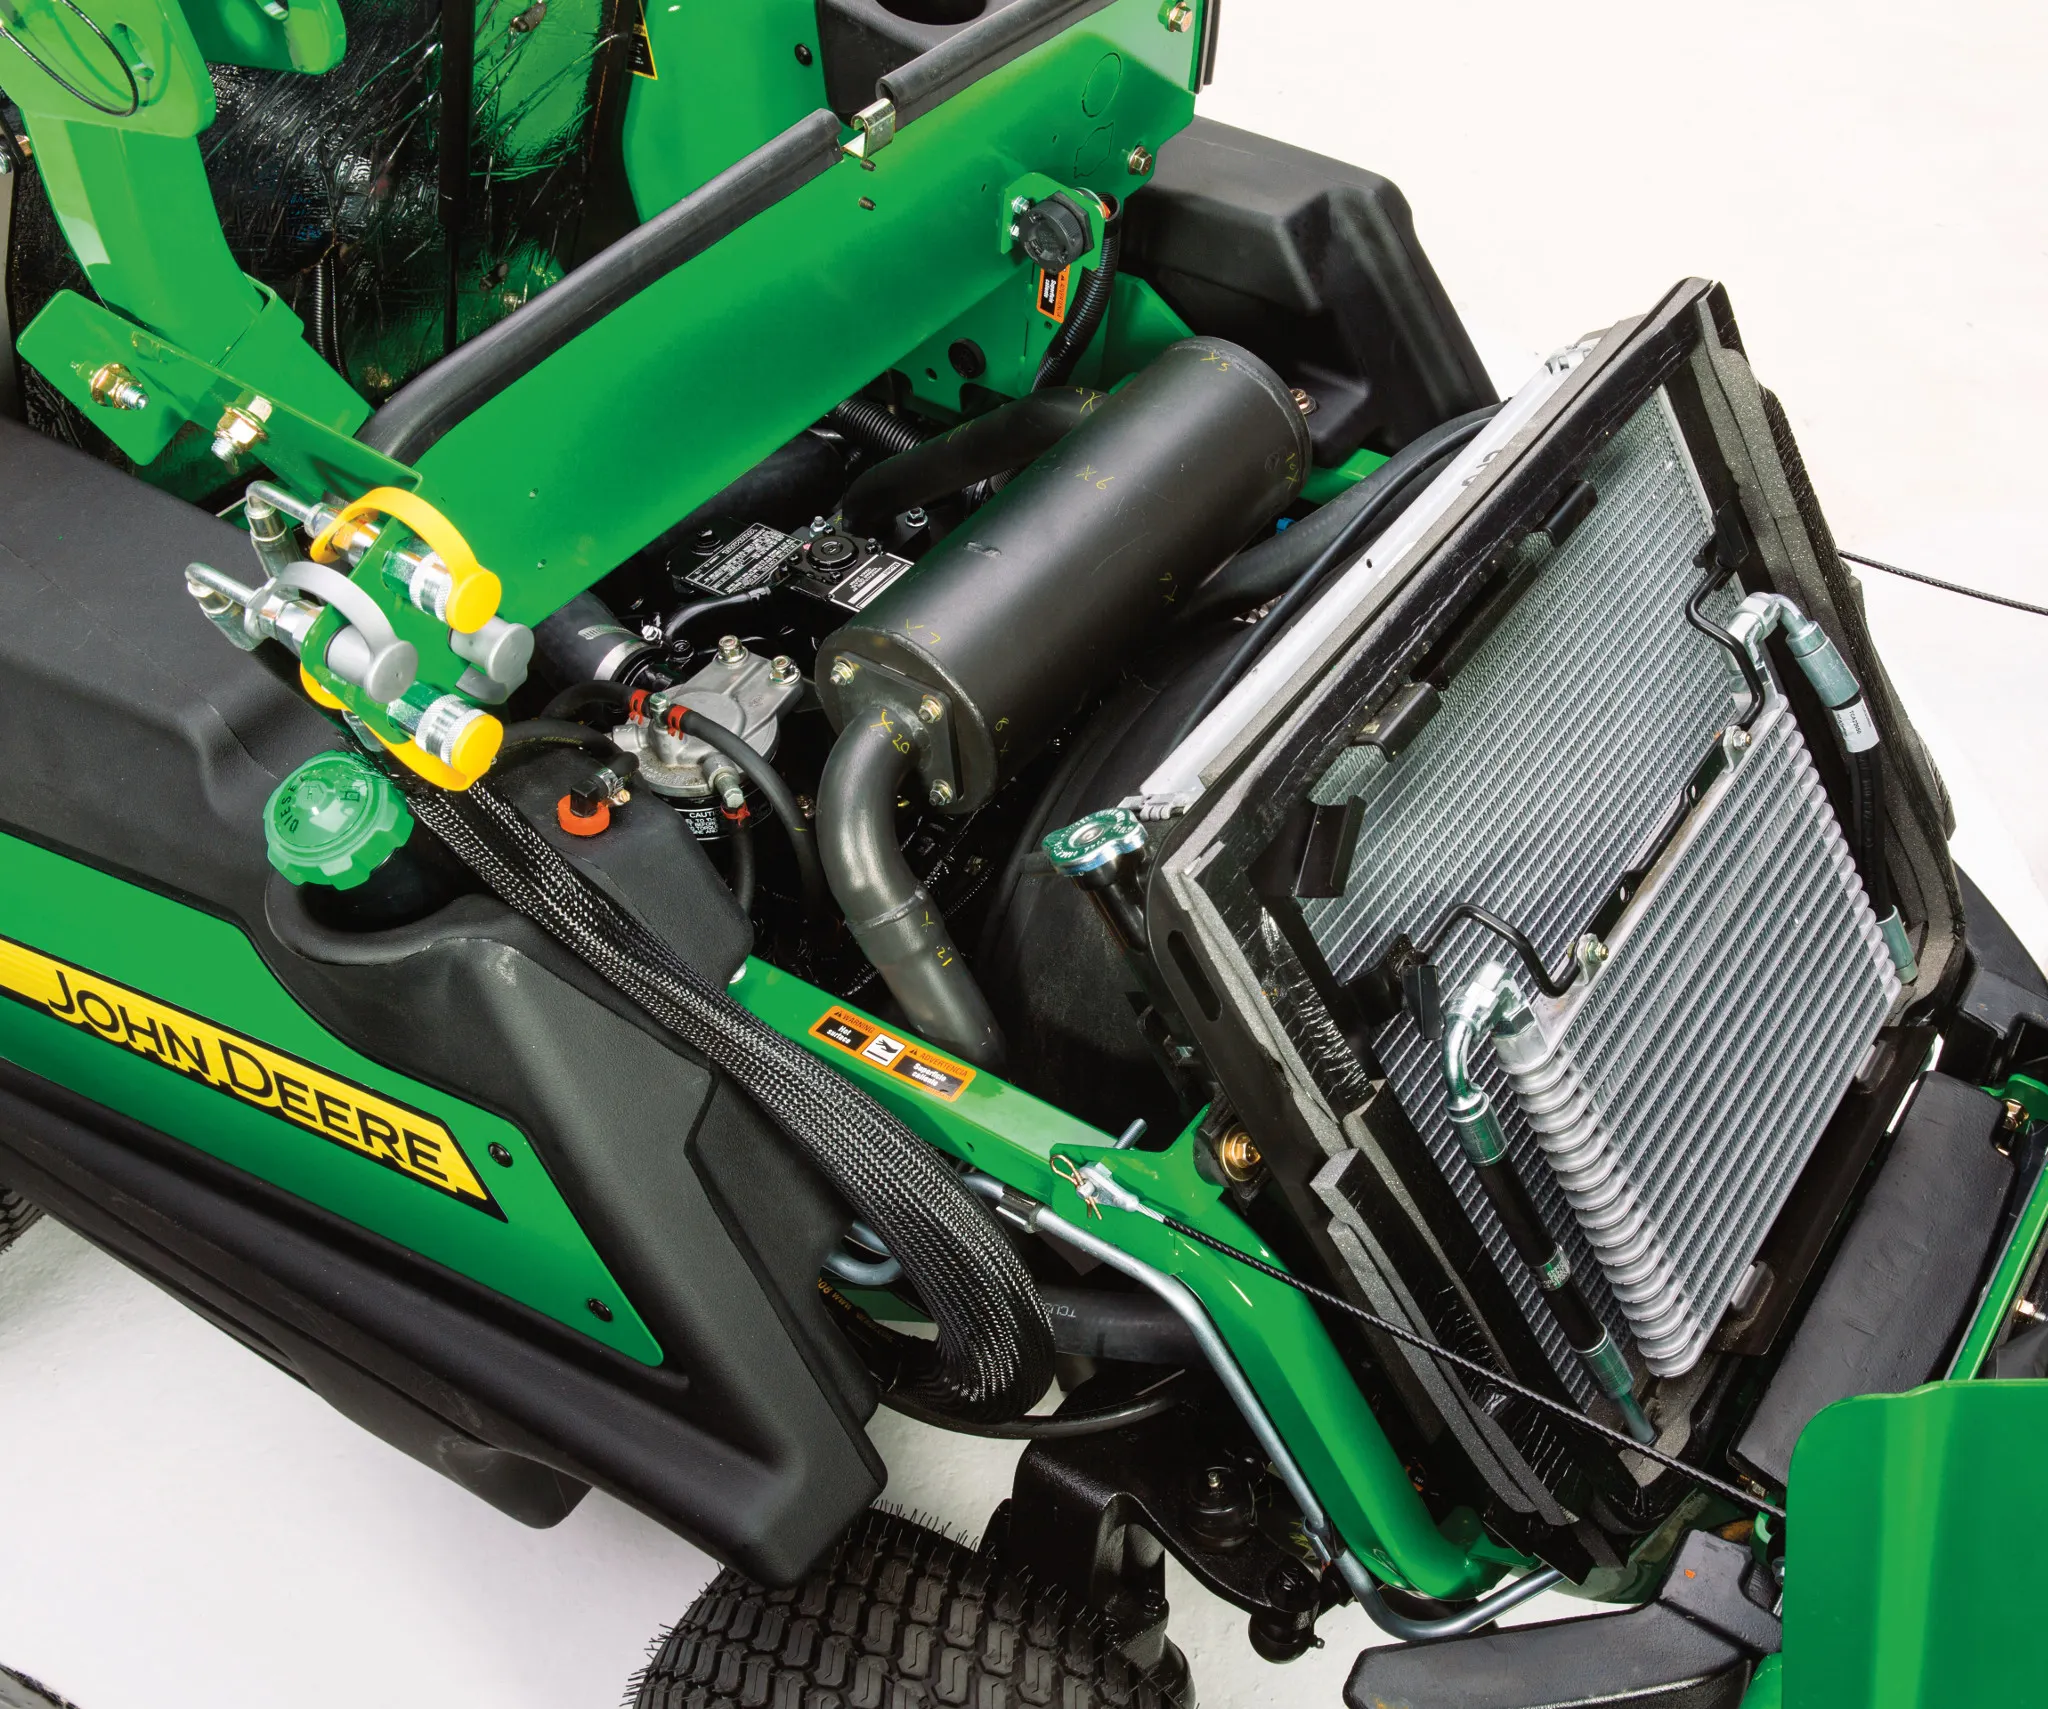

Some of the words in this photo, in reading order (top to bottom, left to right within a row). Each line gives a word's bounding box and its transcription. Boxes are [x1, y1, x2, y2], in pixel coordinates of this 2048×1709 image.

[837, 1024, 853, 1037] Hot
[842, 1011, 877, 1035] WARNING
[826, 1028, 852, 1045] surface
[47, 969, 211, 1076] JOHN
[218, 1038, 449, 1183] DEERE
[912, 1062, 947, 1083] Superficie
[919, 1052, 969, 1078] ADVERTENCIA
